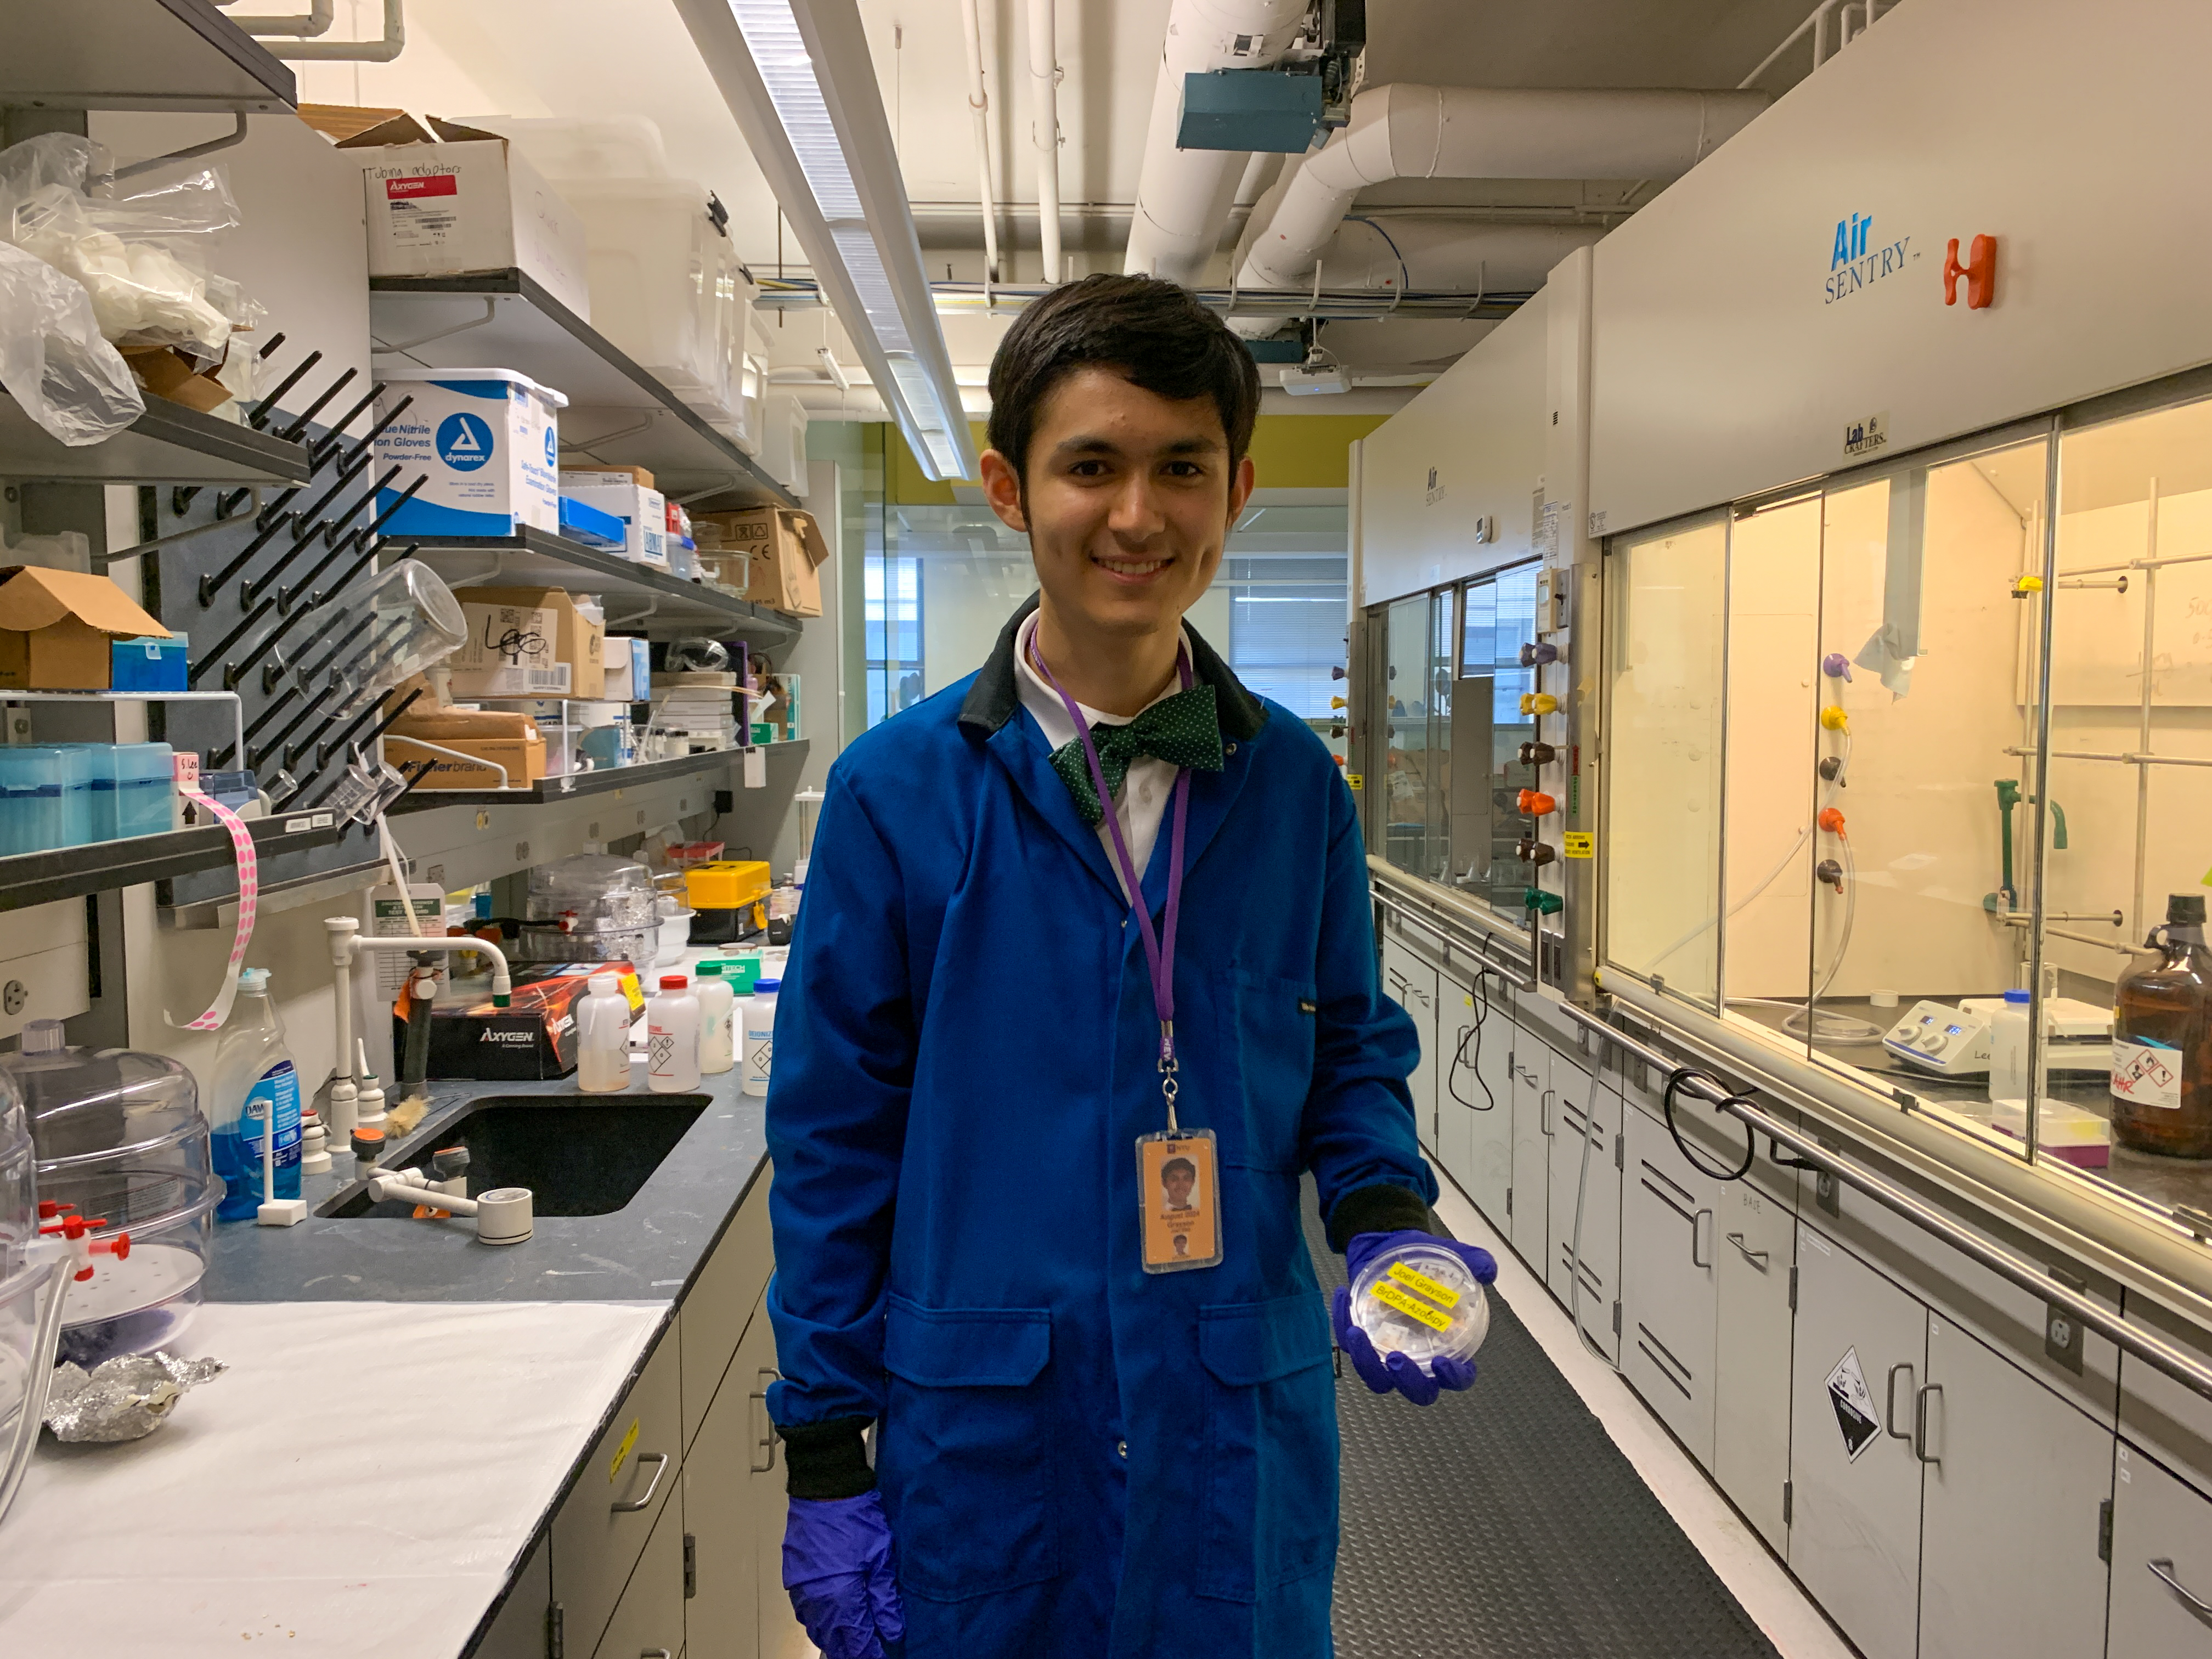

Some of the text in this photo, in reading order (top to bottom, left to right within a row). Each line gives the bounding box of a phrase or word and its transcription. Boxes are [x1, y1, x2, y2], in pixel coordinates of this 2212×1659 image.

[366, 163, 462, 182] Tubing adaptors
[390, 180, 426, 191] AXYGEN
[1831, 212, 1872, 272] Air
[1825, 236, 1911, 304] SENTRY
[399, 425, 431, 434] Nitrile
[1846, 423, 1863, 446] Lab
[394, 437, 431, 447] Gloves
[1844, 432, 1884, 454] CRAFTERS
[445, 452, 486, 463] dynarex
[1427, 466, 1437, 492] Air
[480, 1028, 534, 1042] AXYGEN
[1394, 1268, 1415, 1282] Joel
[1415, 1279, 1454, 1304] Grayson
[1840, 1399, 1862, 1425] CORROSIVE
